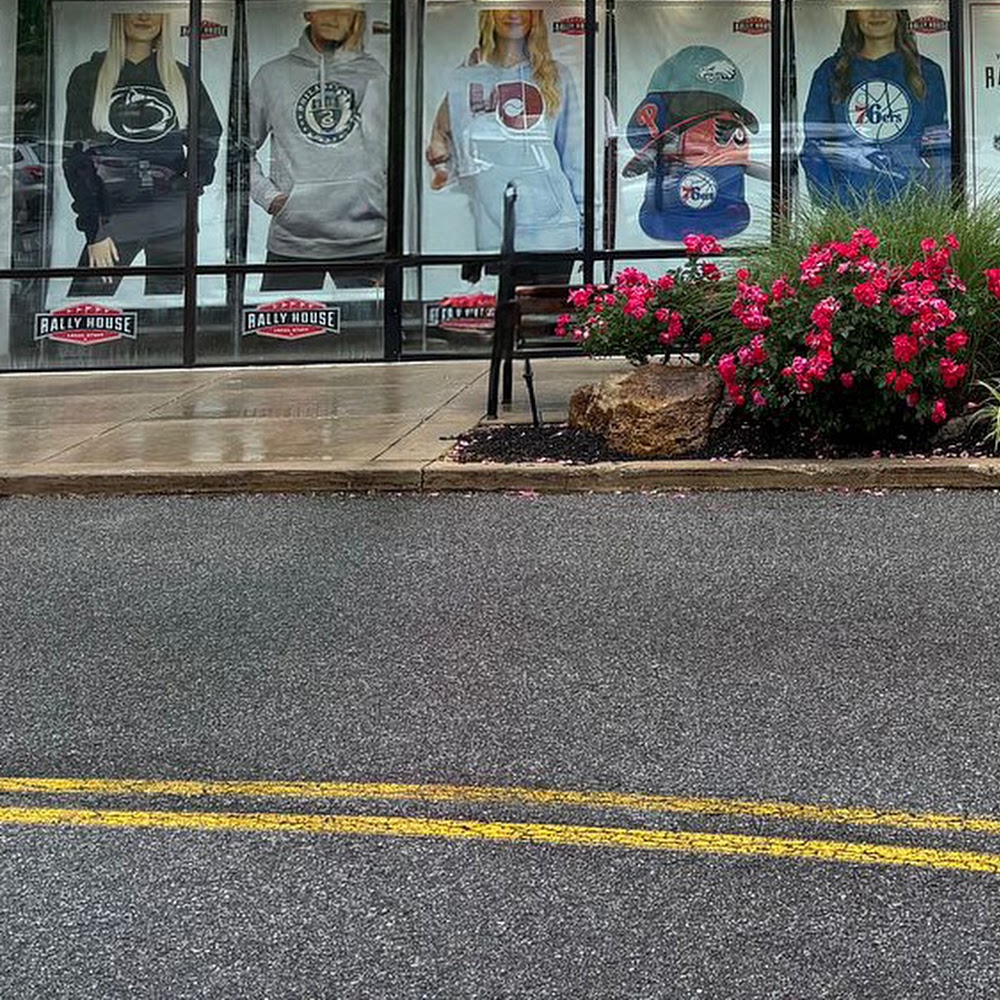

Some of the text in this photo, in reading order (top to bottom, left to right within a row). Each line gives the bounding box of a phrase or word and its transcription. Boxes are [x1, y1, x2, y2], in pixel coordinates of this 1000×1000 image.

[40, 316, 132, 335] RALLY HOUSE
[245, 311, 335, 330] RALLY HOUSE
